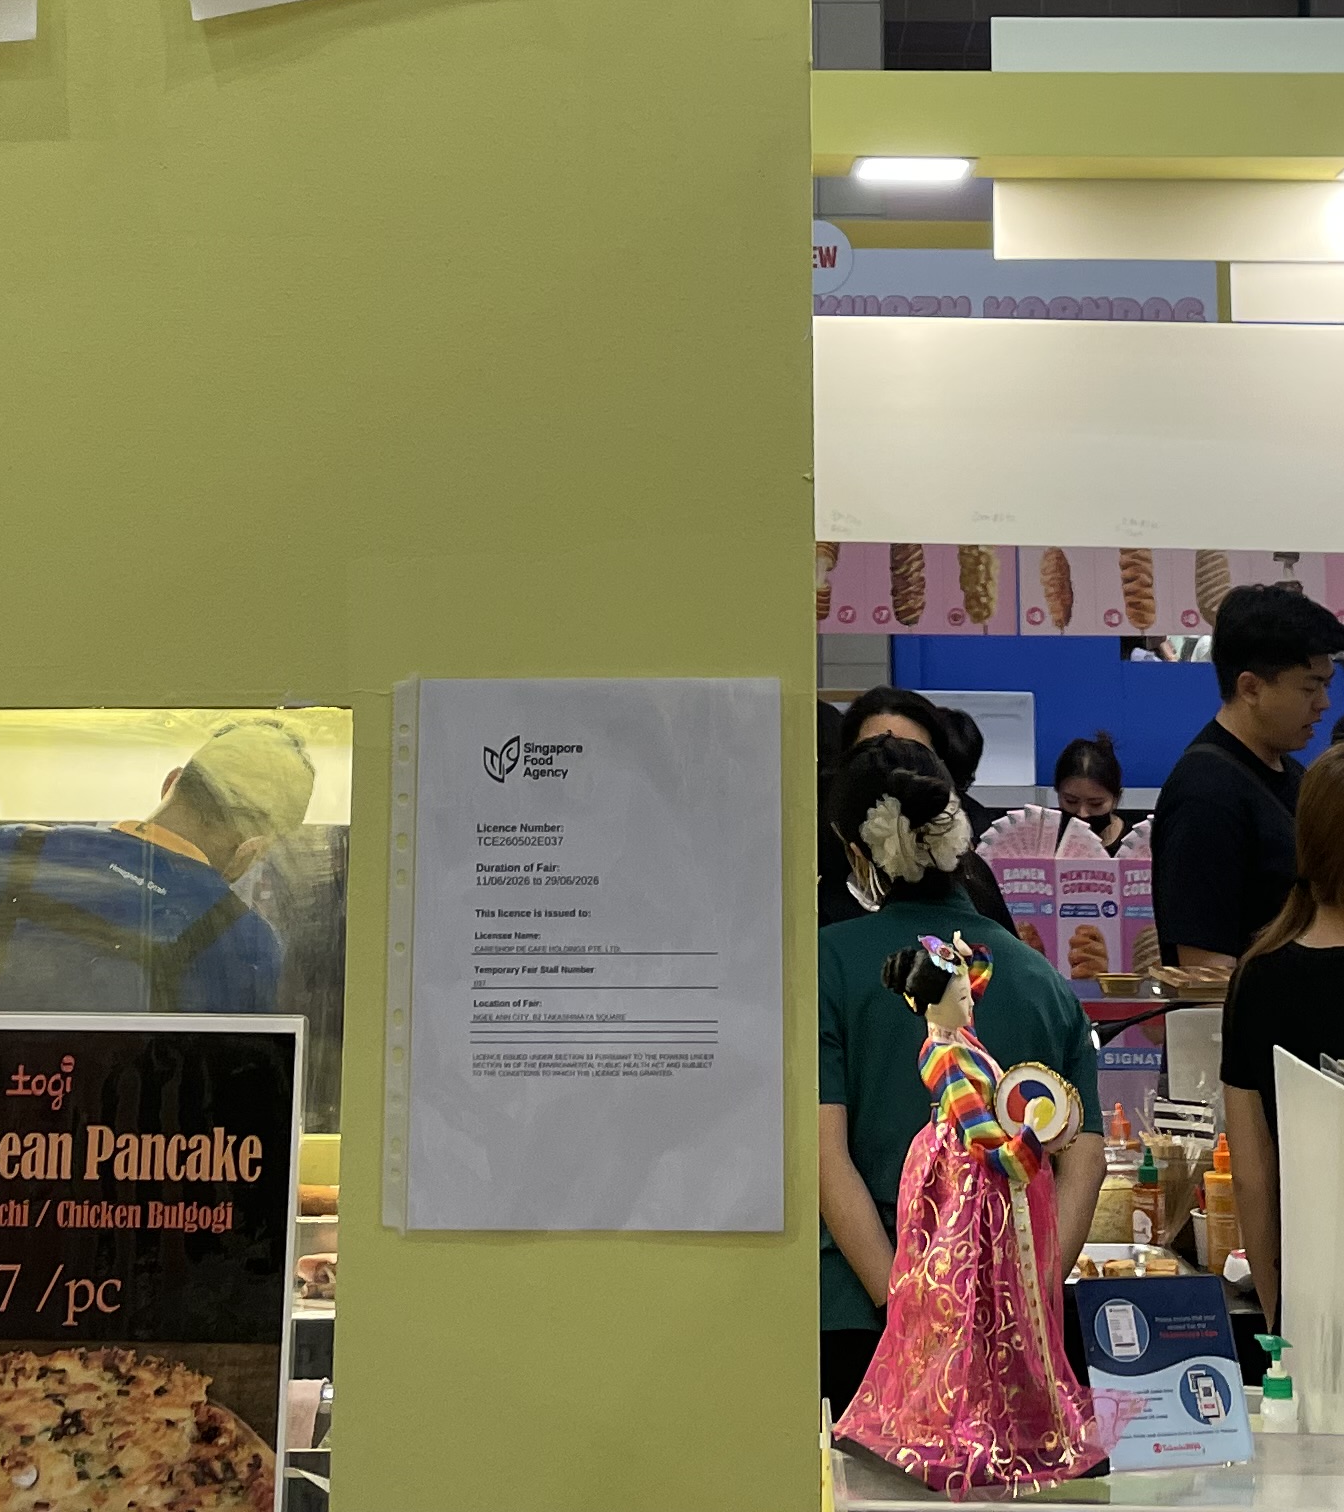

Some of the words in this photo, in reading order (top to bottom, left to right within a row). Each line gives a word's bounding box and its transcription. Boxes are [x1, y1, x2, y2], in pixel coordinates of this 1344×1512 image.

[523, 742, 583, 756] Singapore
[523, 755, 554, 766] Food
[523, 767, 569, 780] Agency
[476, 823, 517, 833] Licence
[519, 823, 564, 833] Number:
[476, 863, 521, 873] Duration
[523, 863, 534, 873] of
[536, 863, 560, 873] Fair:
[532, 876, 543, 886] to
[475, 909, 496, 918] This
[497, 909, 532, 918] licence
[533, 909, 542, 918] is
[544, 909, 576, 918] issued
[474, 966, 520, 975] Temporary
[521, 966, 538, 974] Fair
[473, 999, 511, 1008] Location
[512, 999, 522, 1008] of
[83, 1124, 264, 1183] Pancake
[35, 1199, 52, 1228] /
[56, 1200, 142, 1230] Chicken
[146, 1201, 235, 1234] Bulgogi
[35, 1264, 123, 1326] /pc
